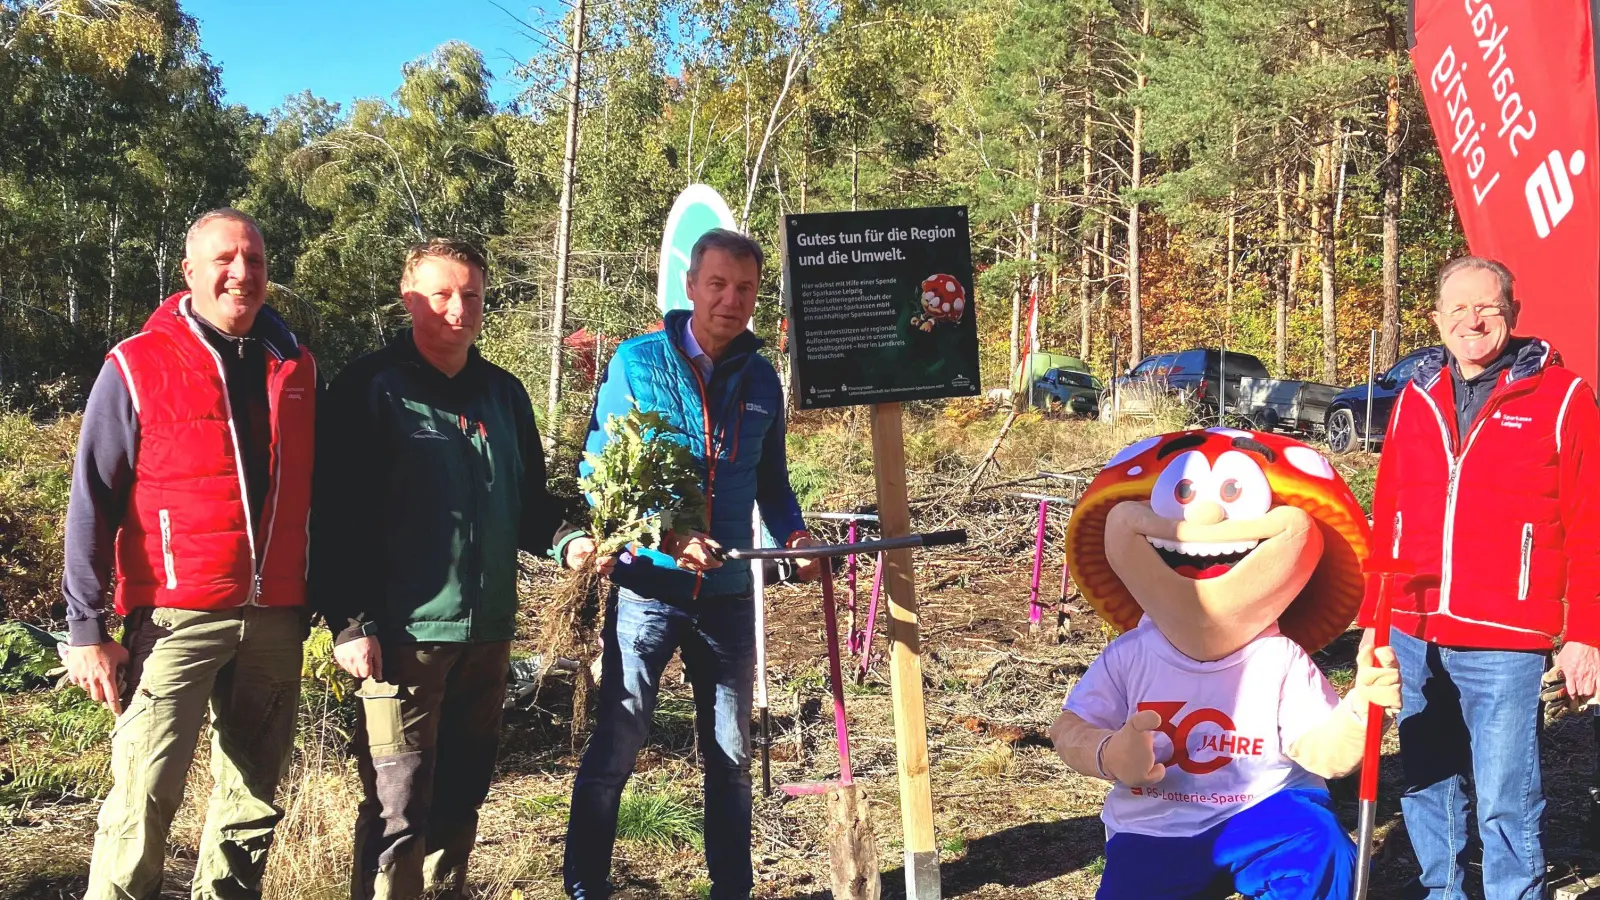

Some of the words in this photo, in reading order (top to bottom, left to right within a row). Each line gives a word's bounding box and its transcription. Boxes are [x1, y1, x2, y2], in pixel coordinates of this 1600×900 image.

[797, 233, 836, 246] Gutes
[839, 231, 862, 244] tun
[865, 228, 885, 242] für
[887, 227, 908, 241] die
[911, 225, 956, 243] Region
[798, 251, 825, 266] und
[828, 250, 848, 264] die
[851, 247, 906, 263] Umwelt.
[846, 279, 859, 287] Hilfe
[812, 289, 841, 297] Sparkasse
[843, 303, 875, 311] Sparkassen
[814, 312, 850, 320] nachhaltiger
[823, 328, 860, 336] unterstützen
[870, 324, 897, 333] regionale
[878, 339, 906, 348] Landkreis
[1196, 735, 1264, 756] JAHRE
[1146, 787, 1254, 805] PS-Lotterie-Sparen
